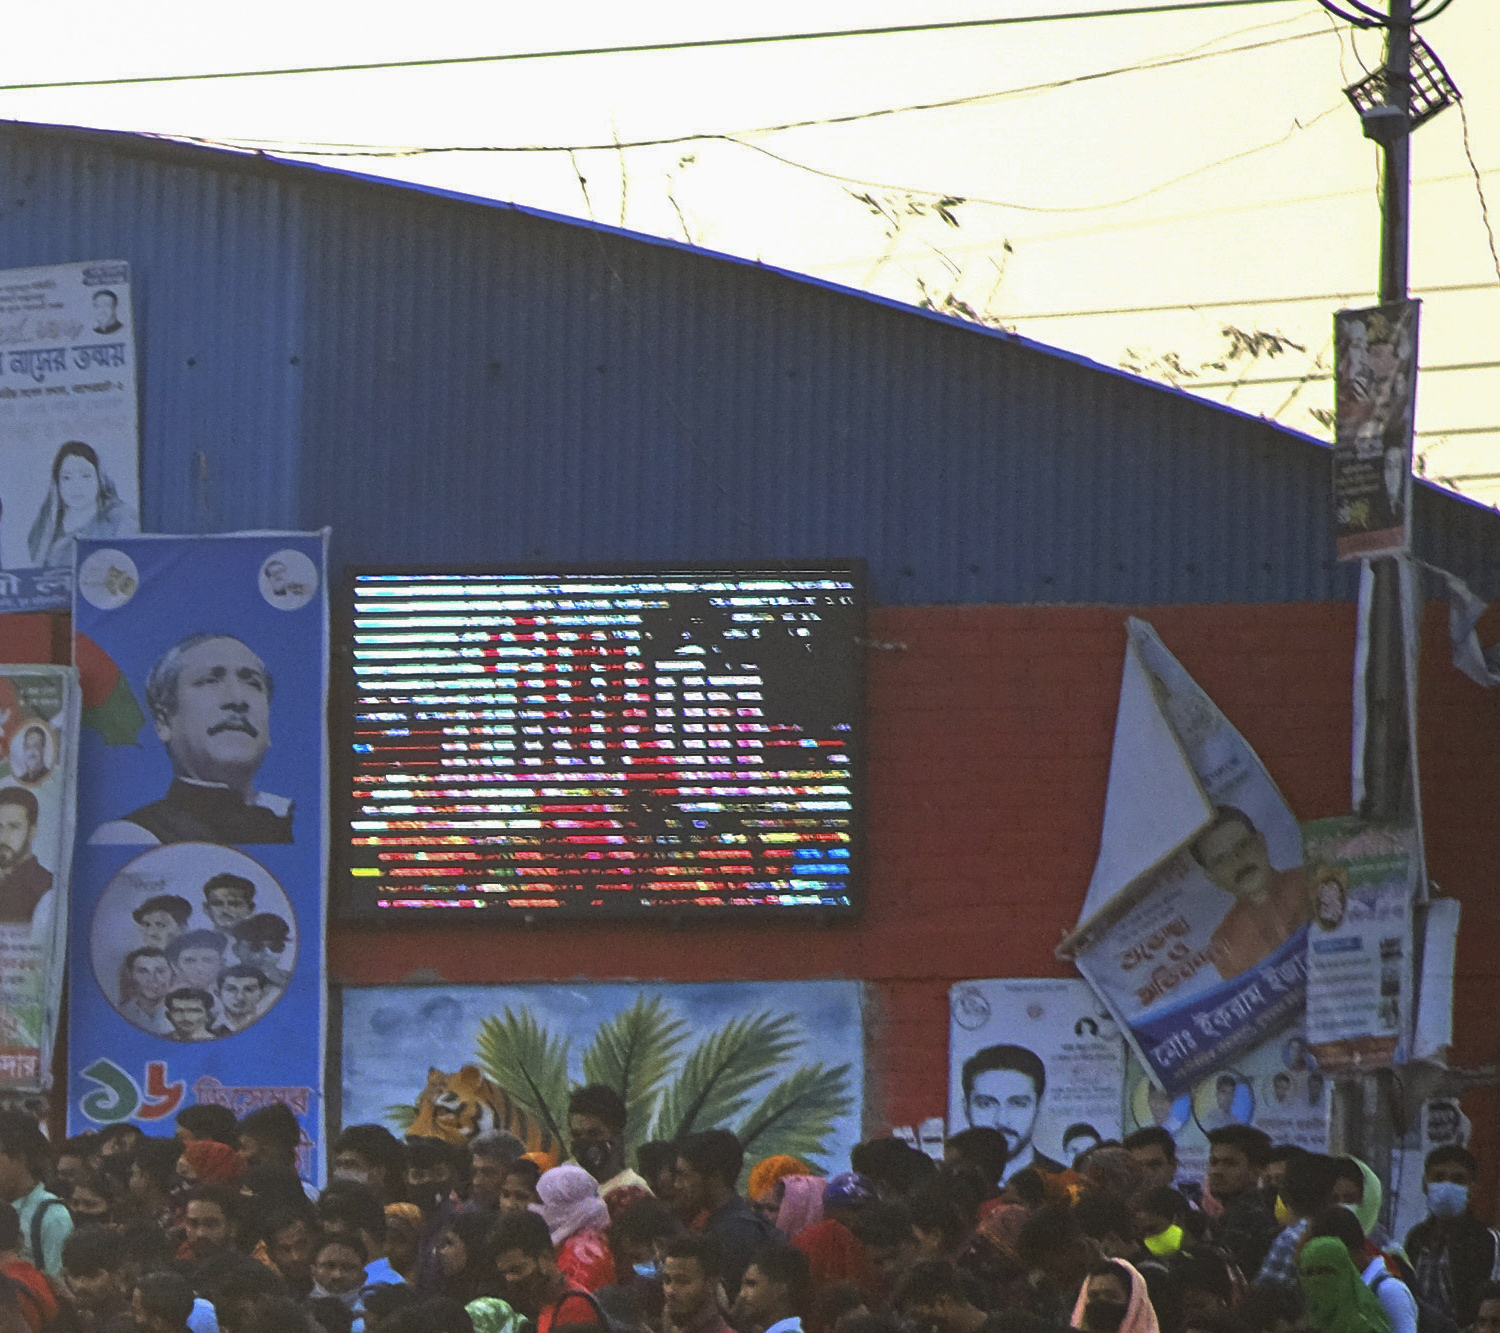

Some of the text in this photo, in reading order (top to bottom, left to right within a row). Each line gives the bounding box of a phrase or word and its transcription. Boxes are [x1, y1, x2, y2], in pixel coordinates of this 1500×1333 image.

[8, 347, 67, 382] নাসের
[1149, 1028, 1199, 1068] মোঃ
[78, 1056, 188, 1124] ১৬
